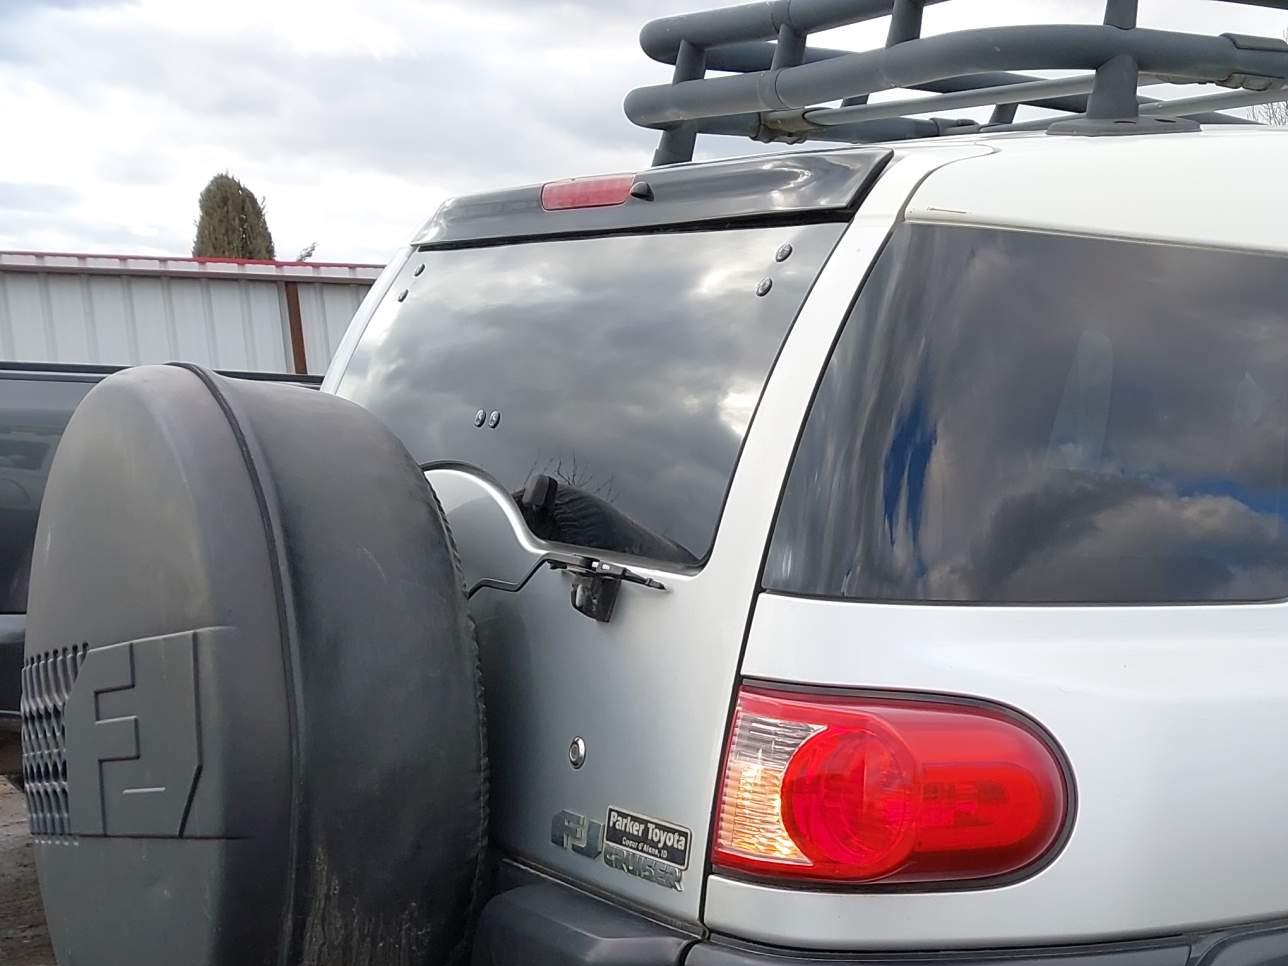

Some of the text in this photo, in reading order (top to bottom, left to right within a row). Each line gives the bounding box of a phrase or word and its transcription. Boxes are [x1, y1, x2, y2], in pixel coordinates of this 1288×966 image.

[64, 627, 203, 838] FJ
[551, 808, 604, 860] FJ
[610, 811, 687, 851] Parker Toyota
[603, 845, 685, 892] CRUISER
